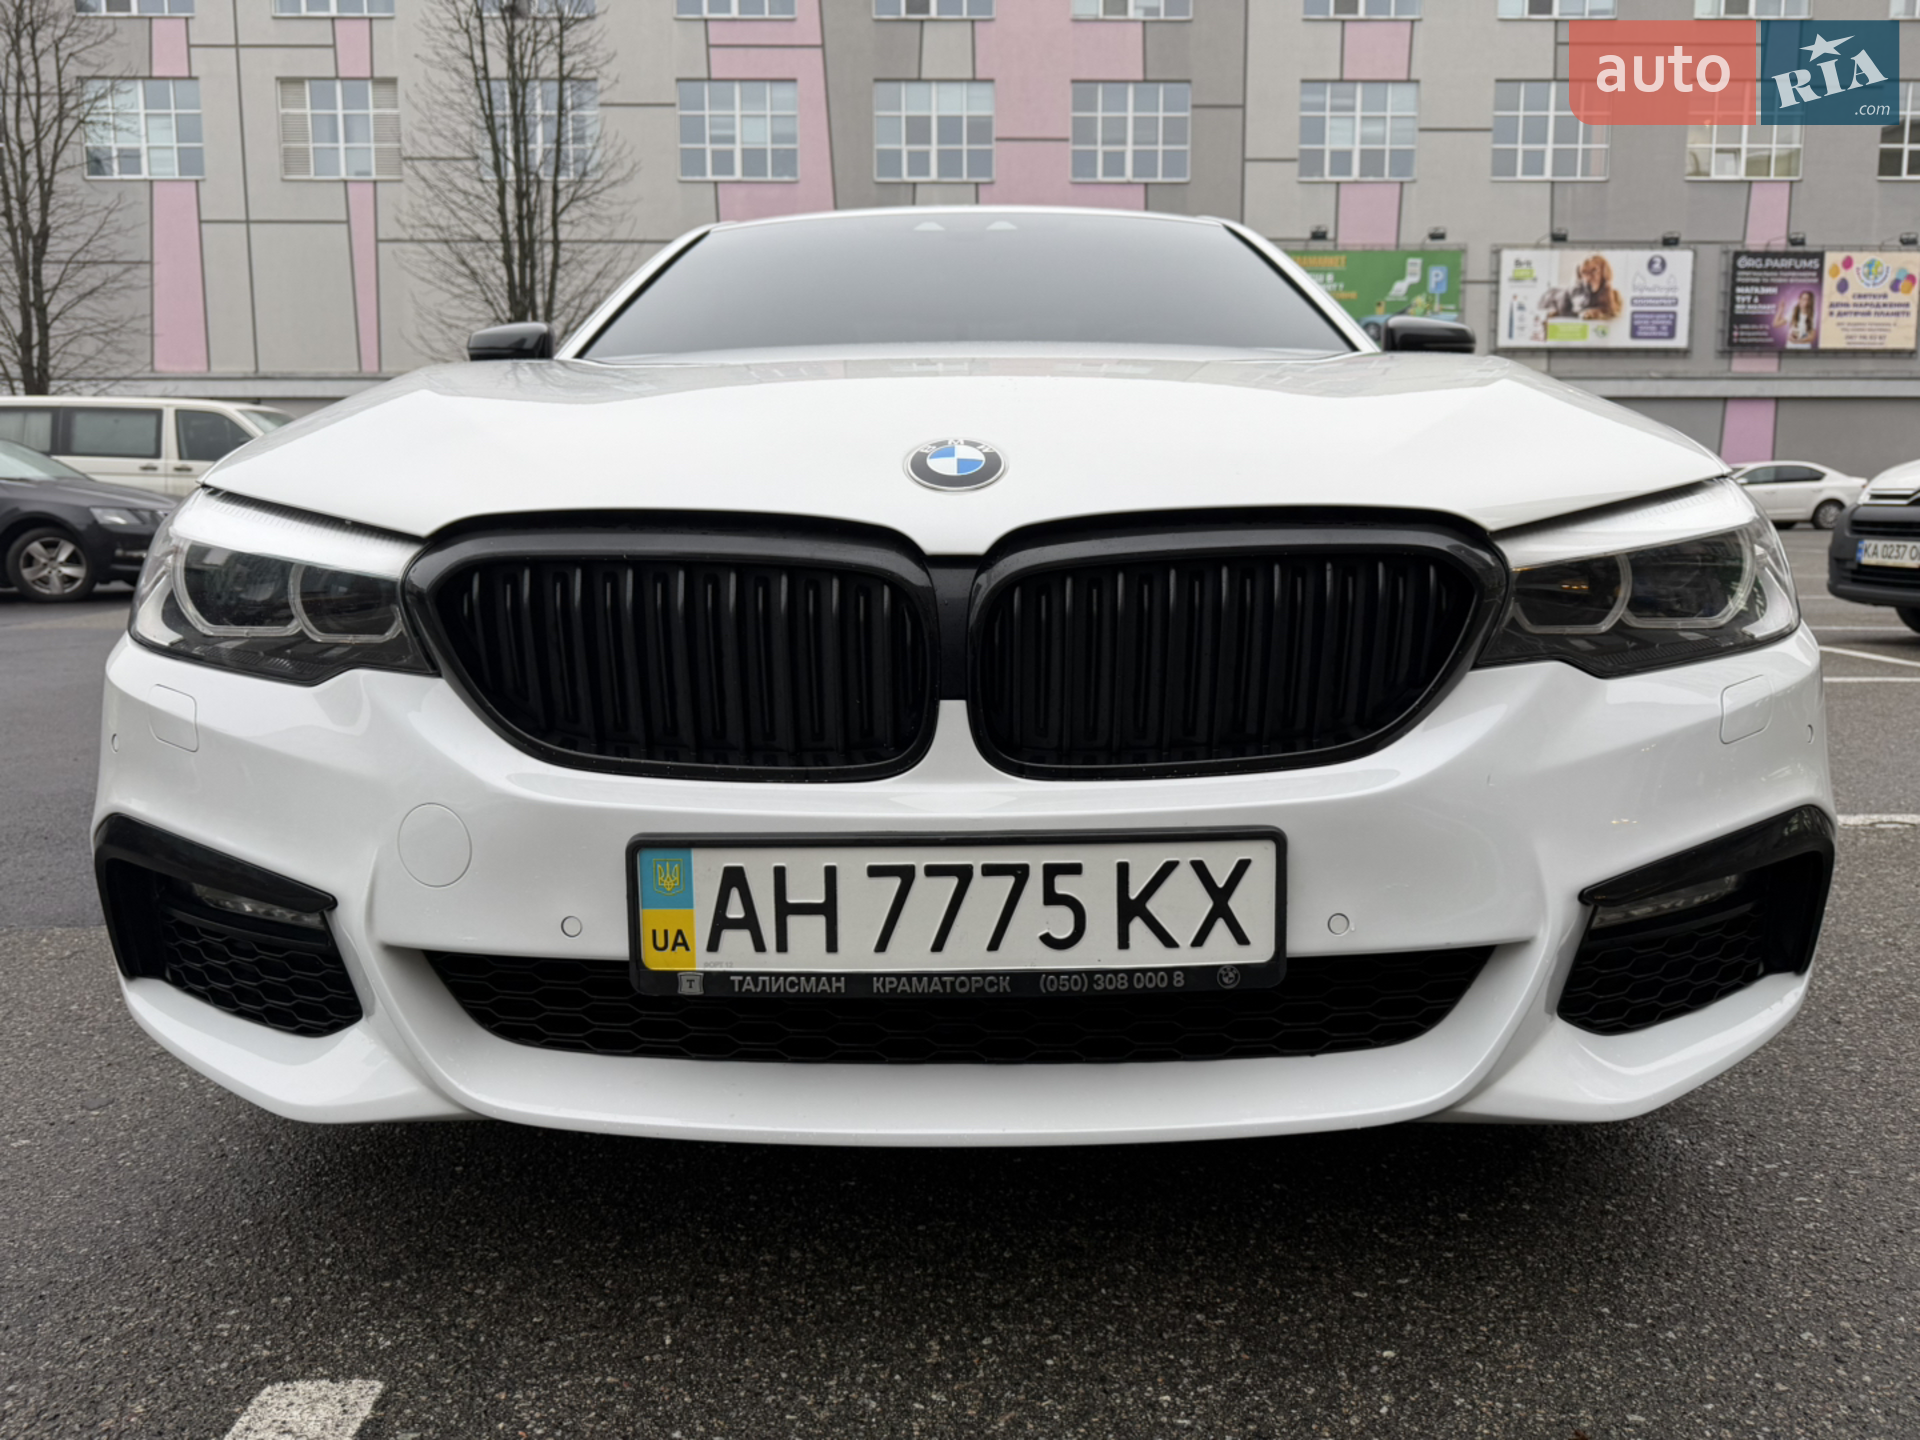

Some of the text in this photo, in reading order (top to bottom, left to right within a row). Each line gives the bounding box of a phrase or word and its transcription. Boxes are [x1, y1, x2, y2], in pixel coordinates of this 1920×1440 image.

[1863, 543, 1920, 560] KA 0237 O
[706, 858, 1252, 953] AH 7775 KX
[652, 928, 690, 952] UA
[730, 970, 1185, 994] ТАЛИСМАН КРАМАТОРСК (050) 308 000 8
